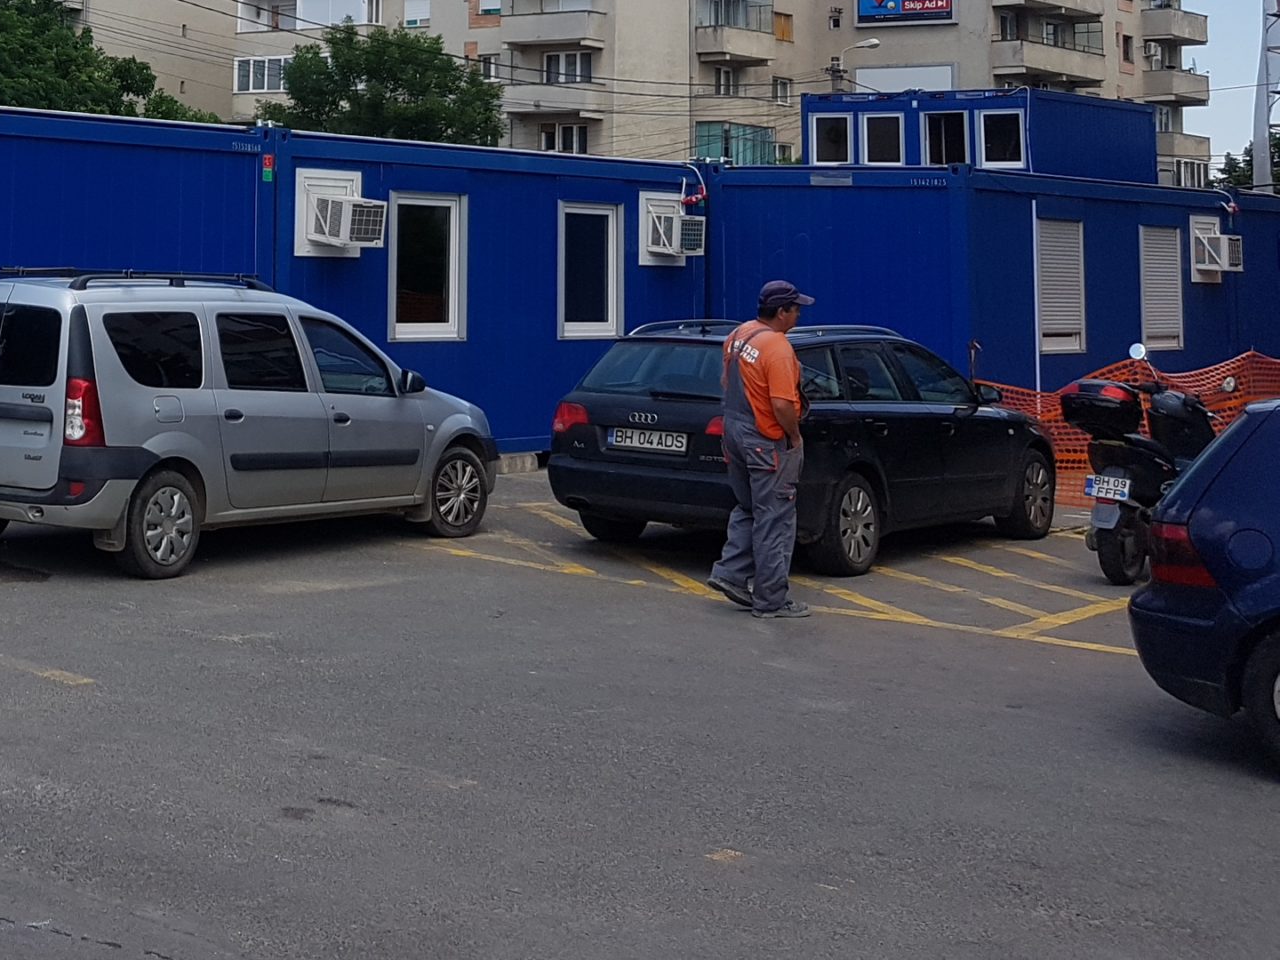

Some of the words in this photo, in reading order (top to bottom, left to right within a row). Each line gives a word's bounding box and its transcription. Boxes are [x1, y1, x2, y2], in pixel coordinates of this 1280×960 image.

[904, 0, 922, 10] Skip
[924, 0, 936, 8] Ad
[615, 430, 633, 444] BH
[638, 432, 653, 445] 04
[657, 434, 685, 448] ADS
[1094, 476, 1110, 486] BH
[1113, 479, 1127, 489] 09
[1097, 487, 1121, 497] FFF
